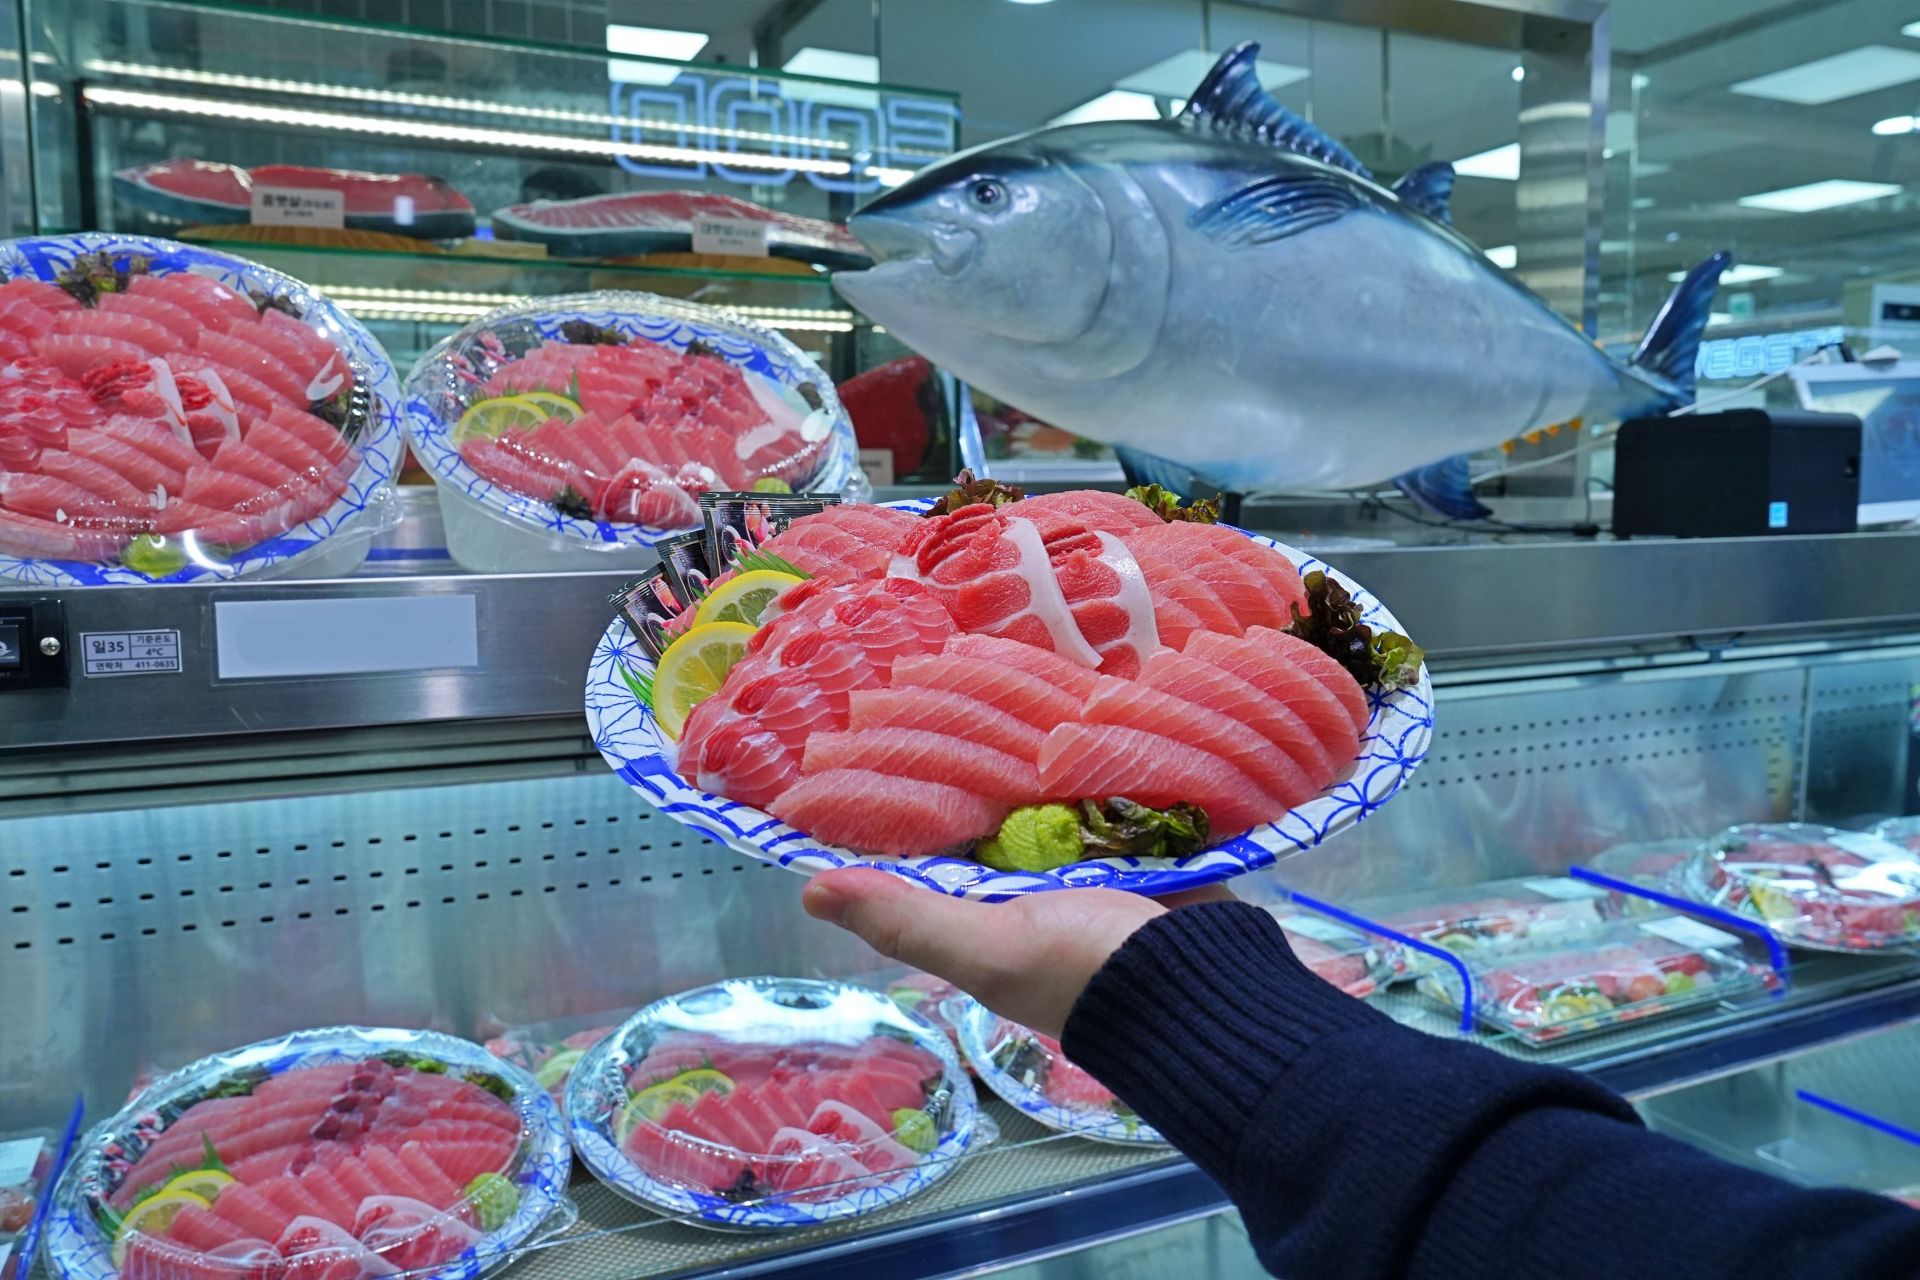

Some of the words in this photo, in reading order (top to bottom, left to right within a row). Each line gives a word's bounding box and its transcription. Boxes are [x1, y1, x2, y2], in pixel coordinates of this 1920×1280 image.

[92, 640, 125, 654] 일35
[95, 661, 123, 671] 연락처
[135, 660, 175, 669] 411-0635
